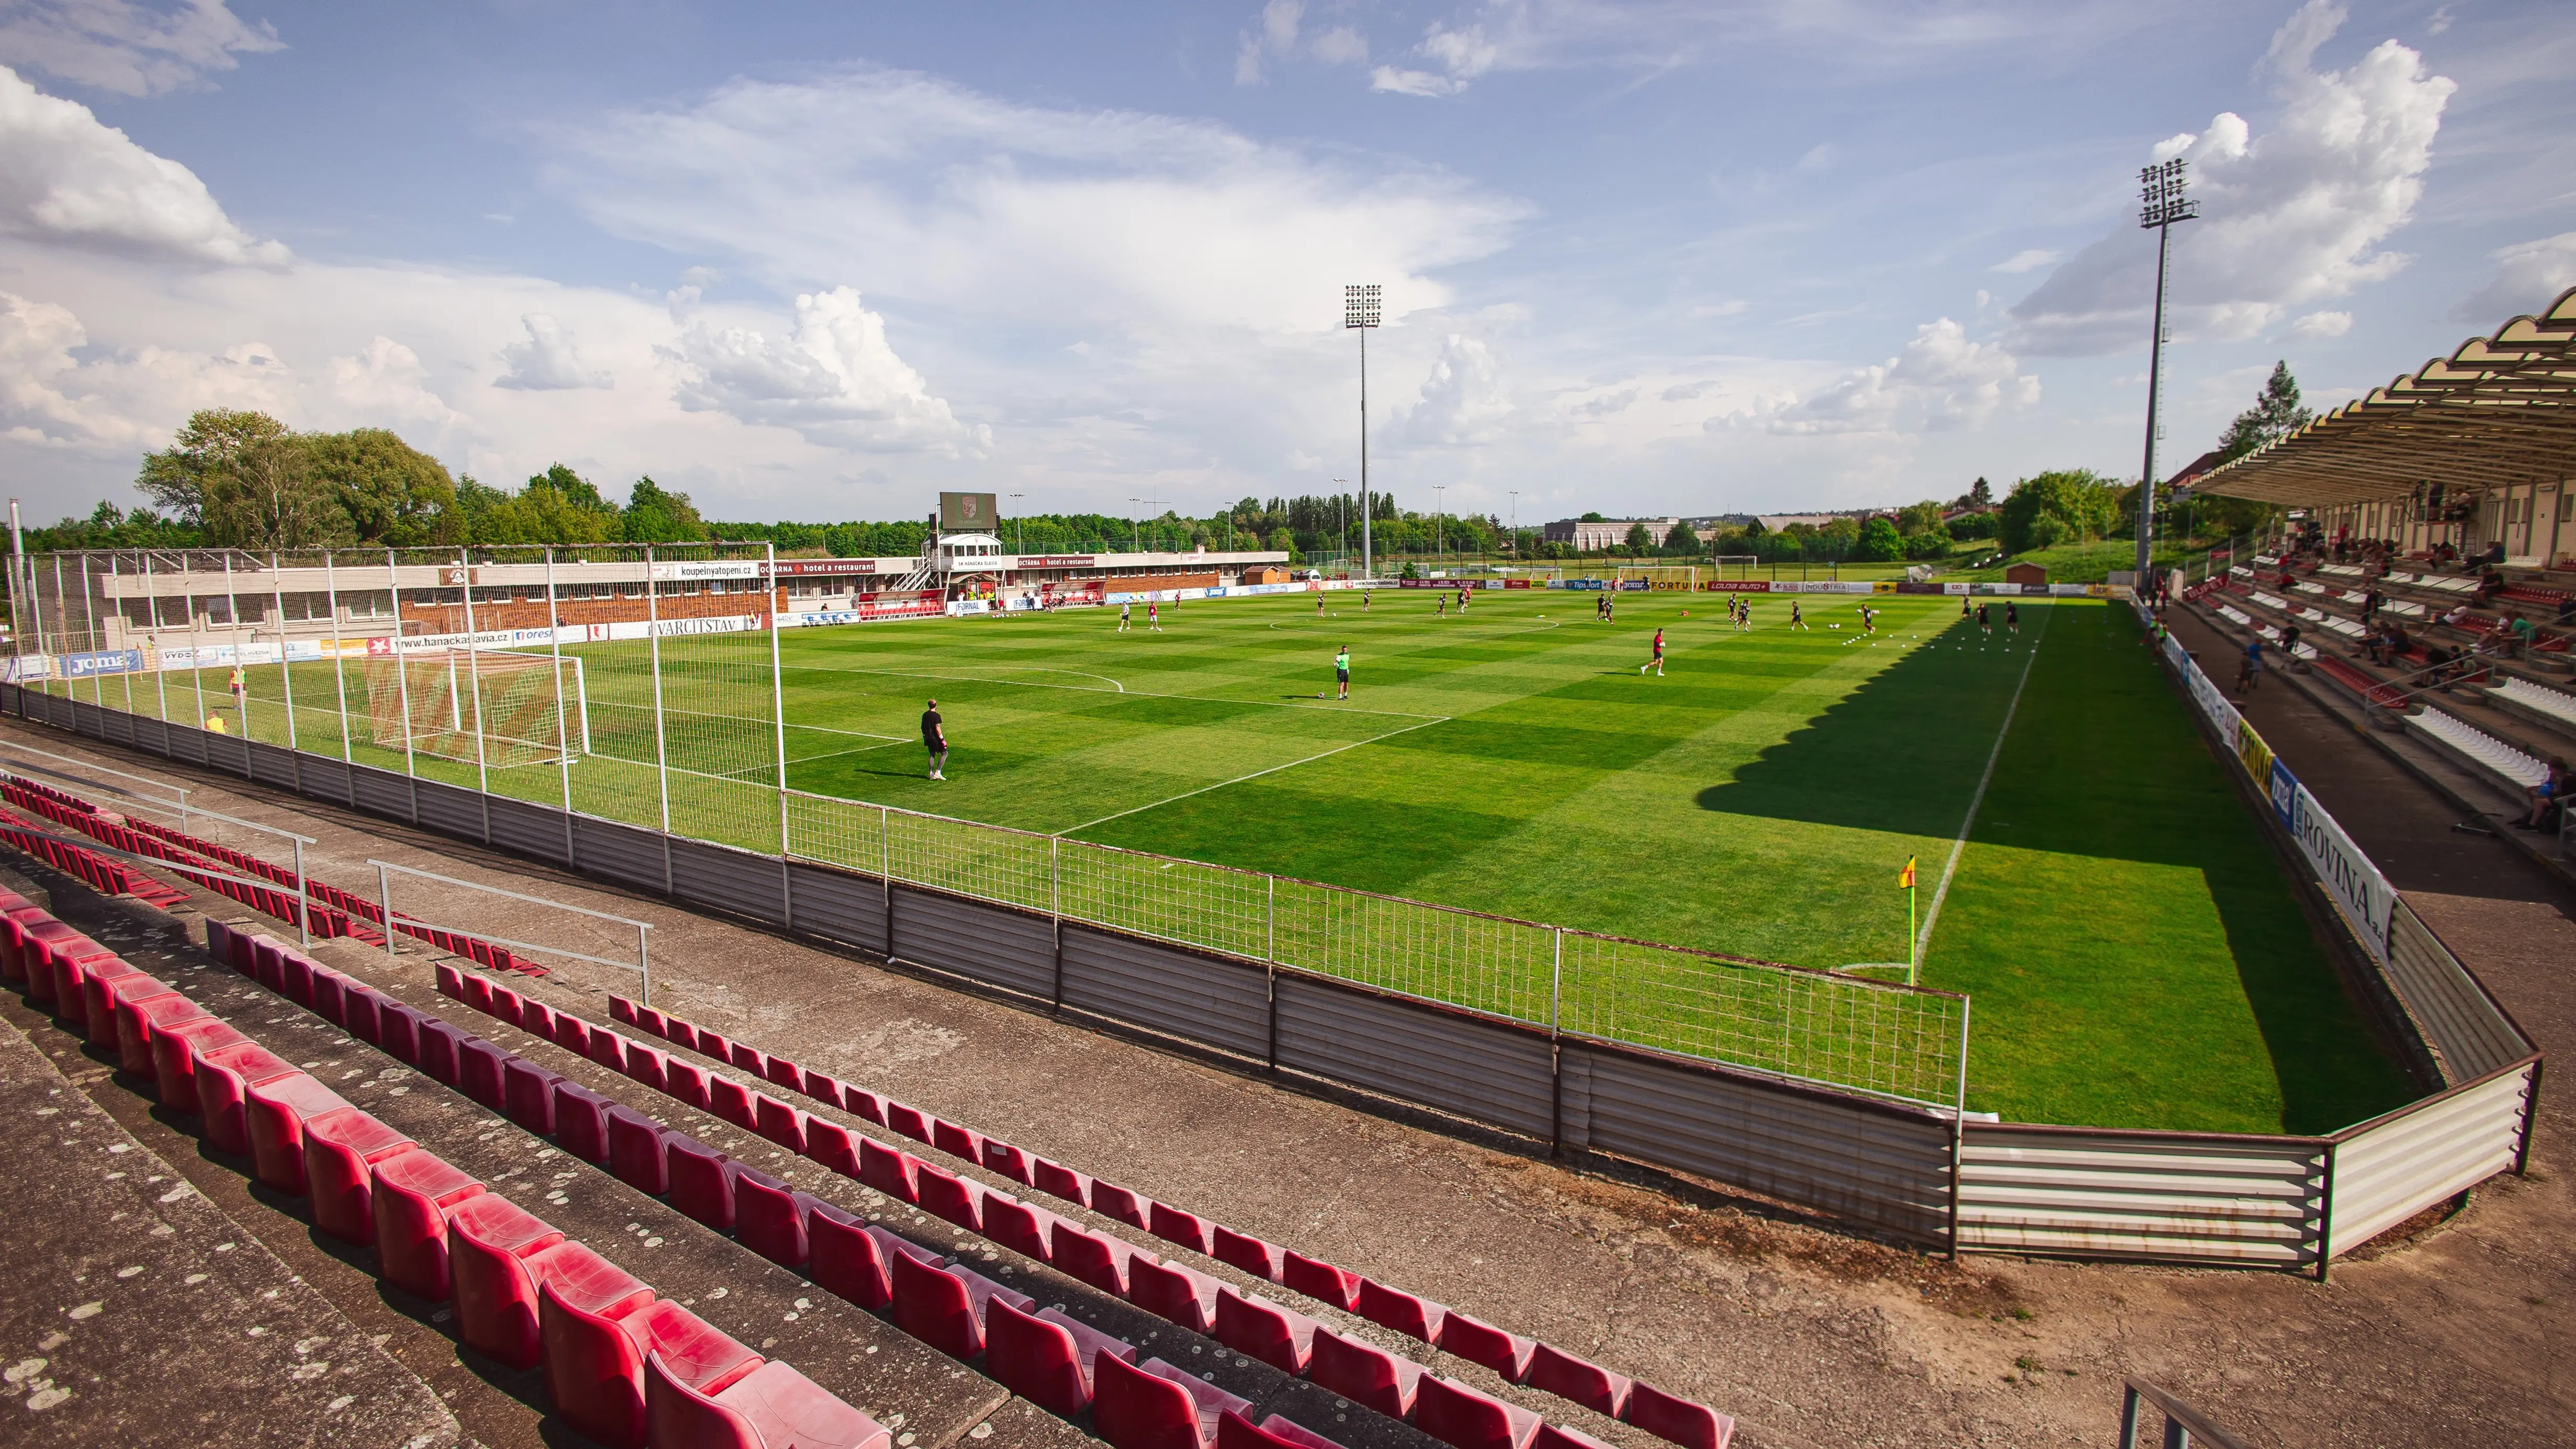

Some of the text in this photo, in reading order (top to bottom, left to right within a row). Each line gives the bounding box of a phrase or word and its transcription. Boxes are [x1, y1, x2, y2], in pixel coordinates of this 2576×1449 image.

[681, 565, 751, 577] koupelnyatopeni.cz
[760, 564, 793, 573] OCÁRNA
[804, 563, 826, 572] hotel
[395, 634, 508, 648] www.hanackaslavia.cz
[2303, 810, 2372, 927] ROVINA
